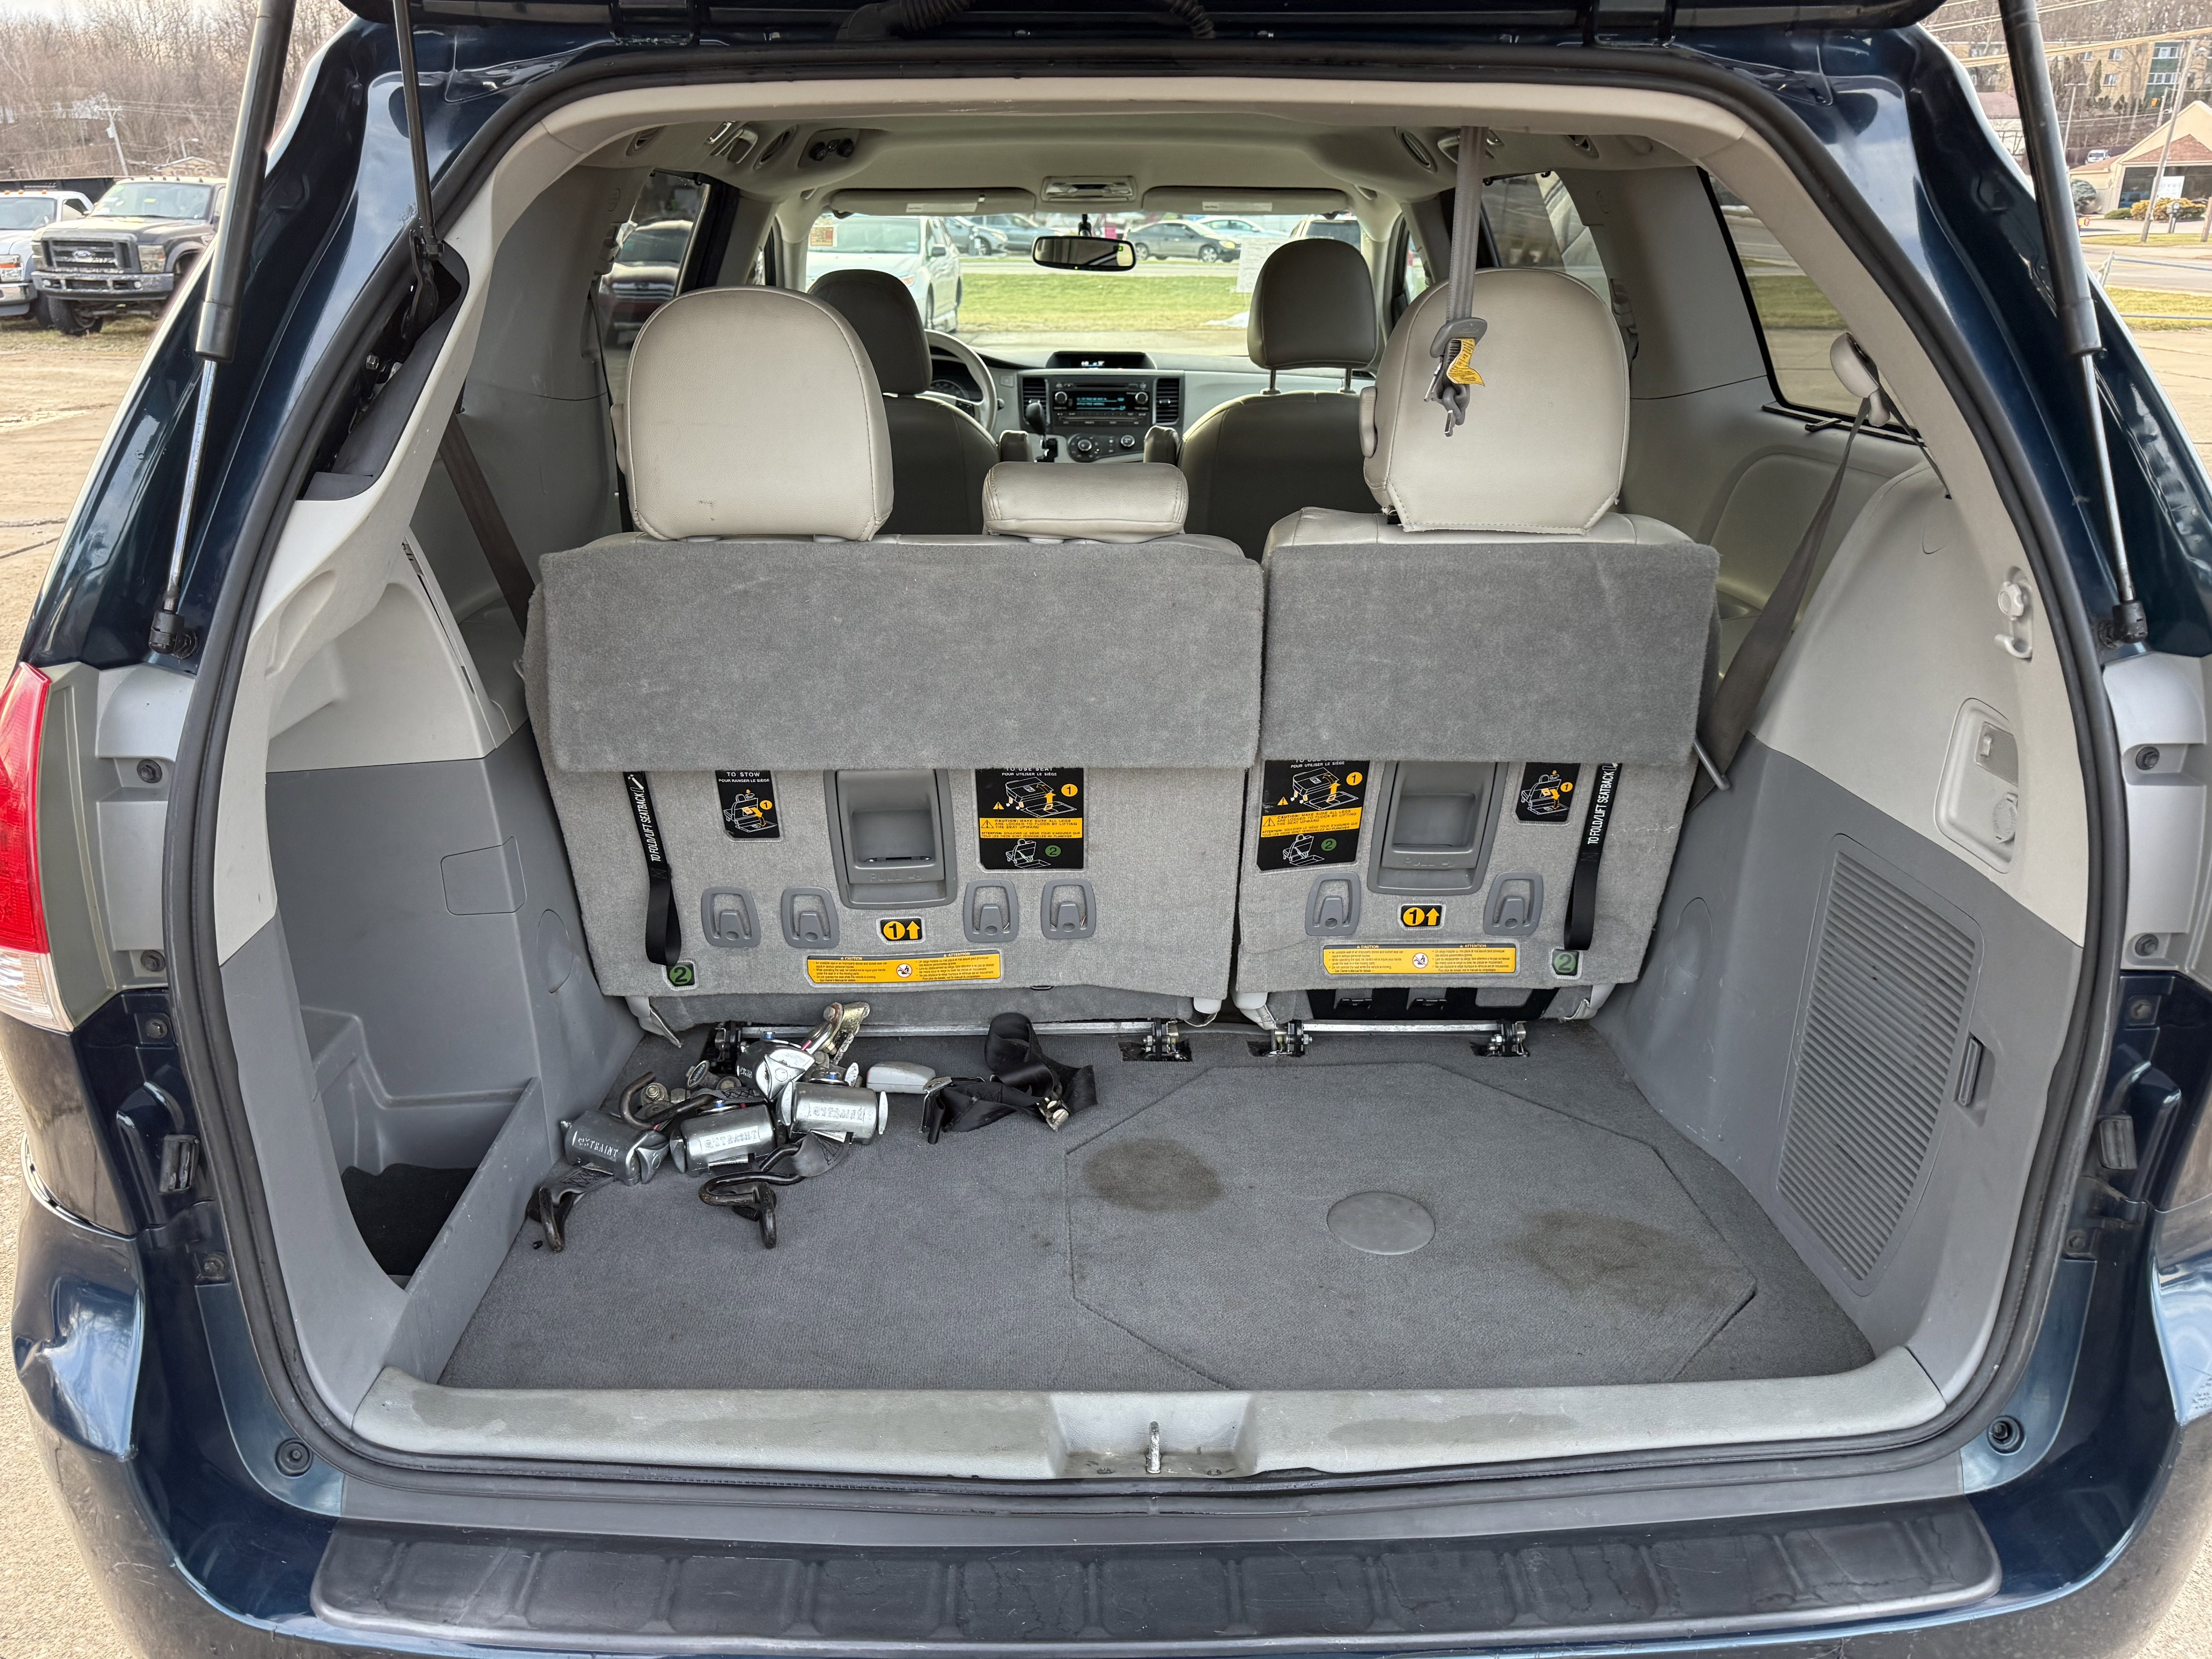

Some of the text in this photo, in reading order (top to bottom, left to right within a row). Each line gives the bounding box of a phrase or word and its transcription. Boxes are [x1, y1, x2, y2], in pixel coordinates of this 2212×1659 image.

[1597, 771, 1614, 803] SEATBACK
[634, 792, 651, 823] SEATBACK
[1590, 804, 1607, 836] FOLD/LIFT
[642, 823, 659, 854] FOLD/LIFT
[1325, 840, 1333, 849] 2
[870, 873, 902, 881] PULL
[1409, 909, 1417, 924] 1
[889, 923, 897, 938] 1
[1558, 954, 1571, 971] 2
[674, 967, 687, 982] 2
